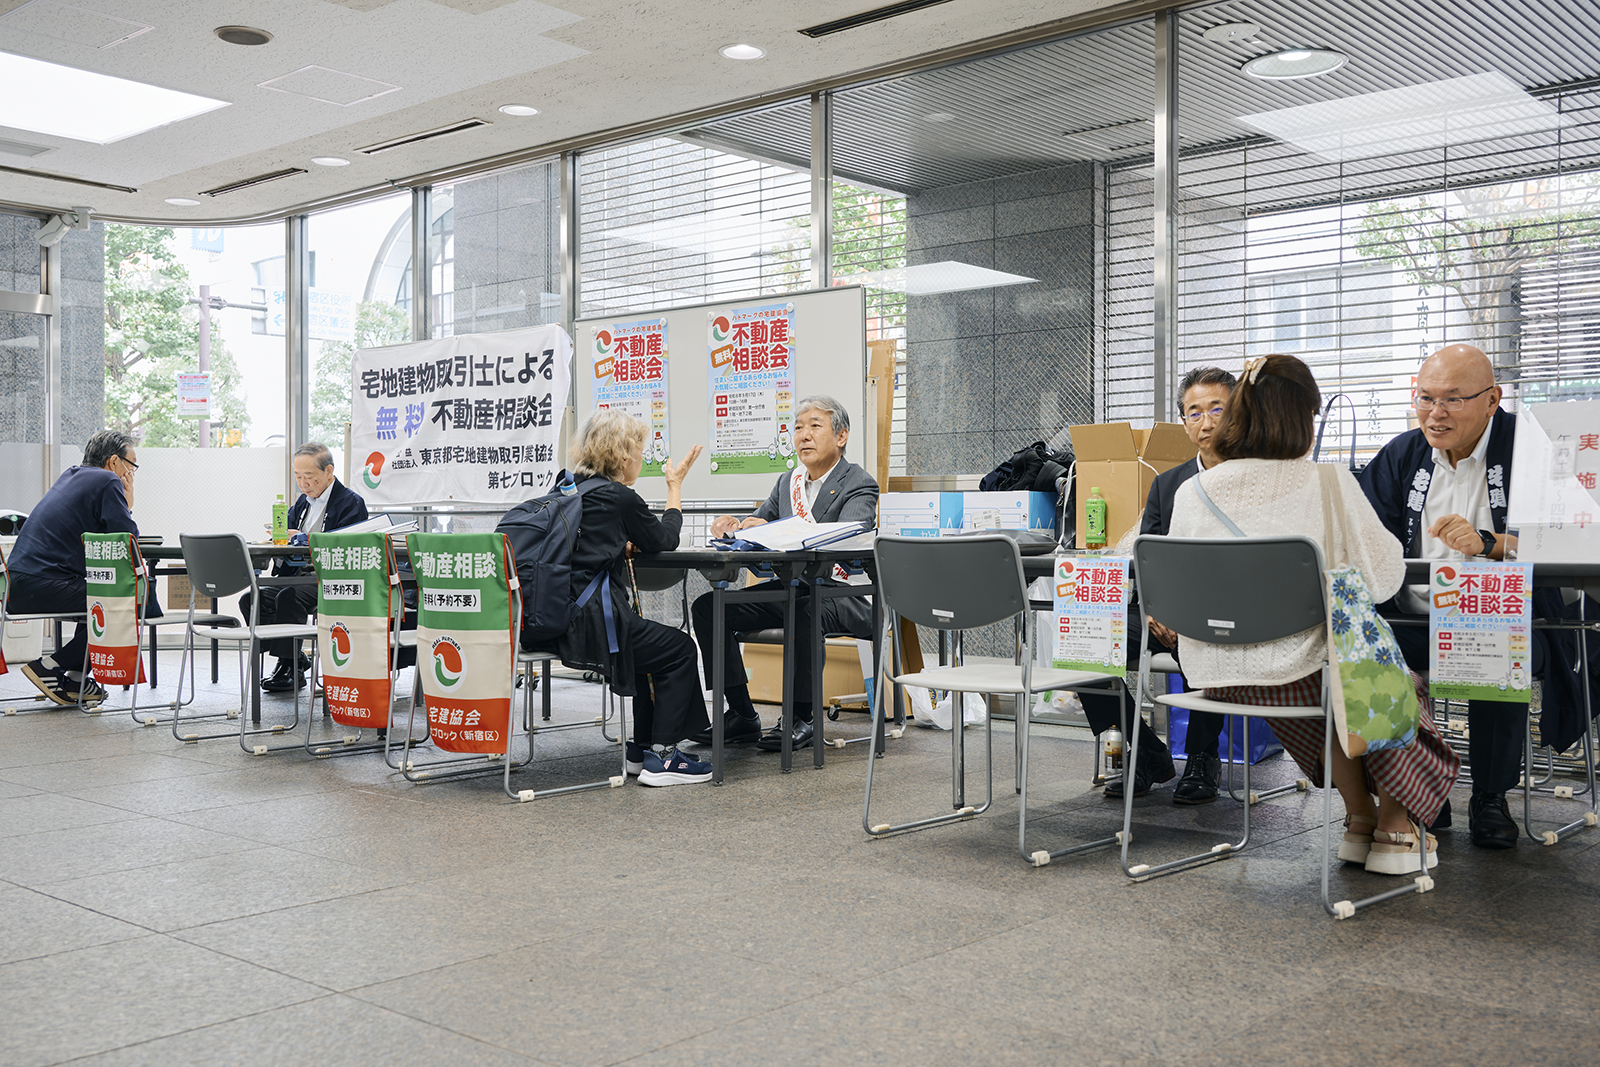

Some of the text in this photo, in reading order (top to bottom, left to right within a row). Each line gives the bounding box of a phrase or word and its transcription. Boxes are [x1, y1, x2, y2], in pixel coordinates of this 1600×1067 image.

[732, 318, 788, 346] 不動産
[614, 333, 662, 359] 不動産
[714, 348, 732, 364] 無料
[732, 344, 788, 372] 相談会
[360, 349, 554, 398] 宅地建物取引士による
[614, 356, 662, 382] 相談会
[376, 393, 552, 440] 無料 不動産相談会
[392, 443, 553, 470] 社団法人 東京都宅地建物取引業協会
[1574, 433, 1599, 529] 実施中
[1076, 568, 1122, 585] 不動産
[1459, 574, 1523, 593] 不動産
[1074, 586, 1122, 603] 相談会
[1459, 595, 1522, 615] 相談会
[326, 685, 359, 702] 宅建協会
[429, 706, 481, 726] 宅建協会
